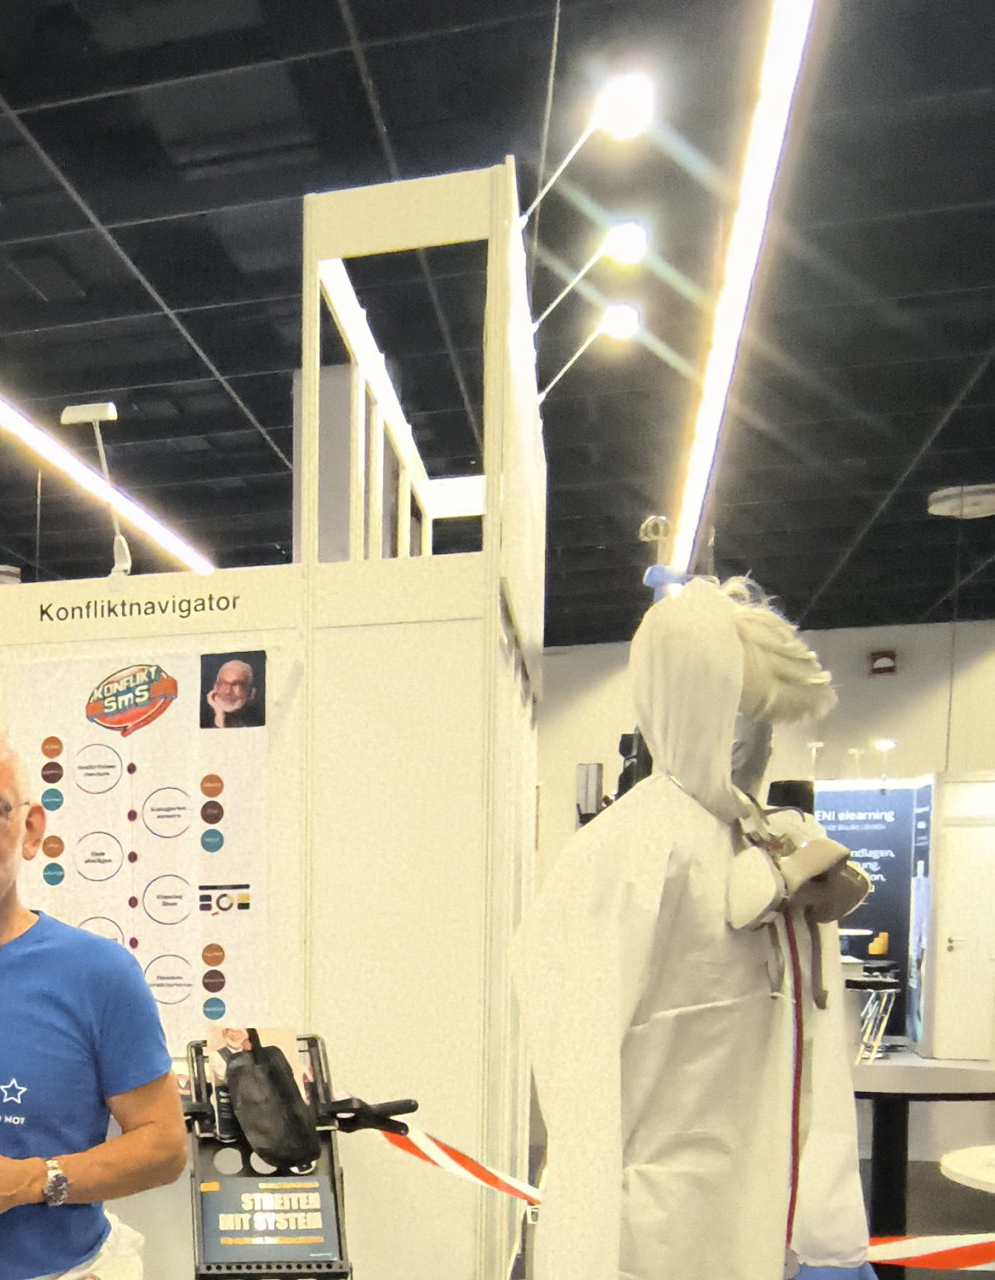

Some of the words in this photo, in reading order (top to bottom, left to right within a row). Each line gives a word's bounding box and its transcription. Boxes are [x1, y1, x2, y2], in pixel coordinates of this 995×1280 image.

[40, 594, 240, 622] Konfliktnavigator
[92, 666, 157, 701] KONFLIKT
[838, 810, 895, 822] elearning
[4, 1115, 26, 1125] NOT
[241, 1192, 321, 1210] STREITEN
[253, 1212, 323, 1231] SYSTEM
